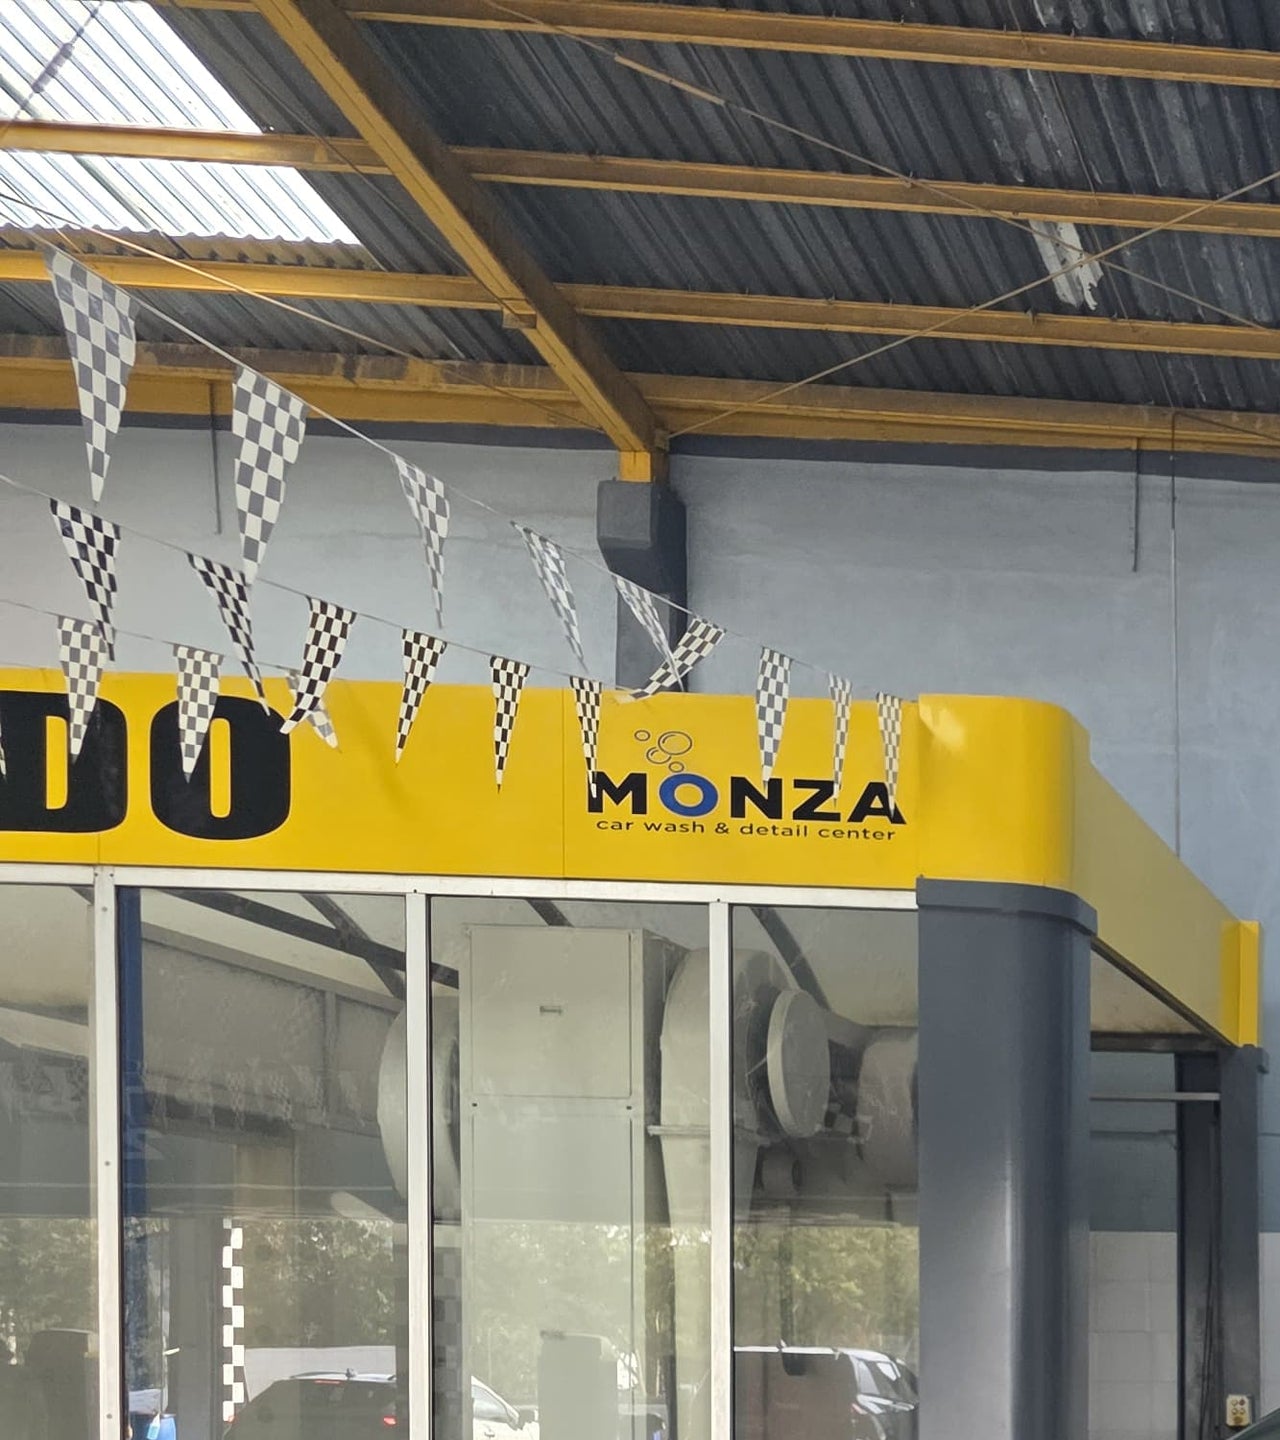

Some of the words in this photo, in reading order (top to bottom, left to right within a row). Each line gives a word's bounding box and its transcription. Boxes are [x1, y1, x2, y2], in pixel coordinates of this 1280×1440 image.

[0, 690, 291, 840] DO
[587, 771, 907, 825] MONZA
[597, 820, 633, 832] car
[643, 820, 705, 834] wash
[715, 822, 730, 835] &
[740, 822, 808, 838] detail
[818, 827, 897, 841] center
